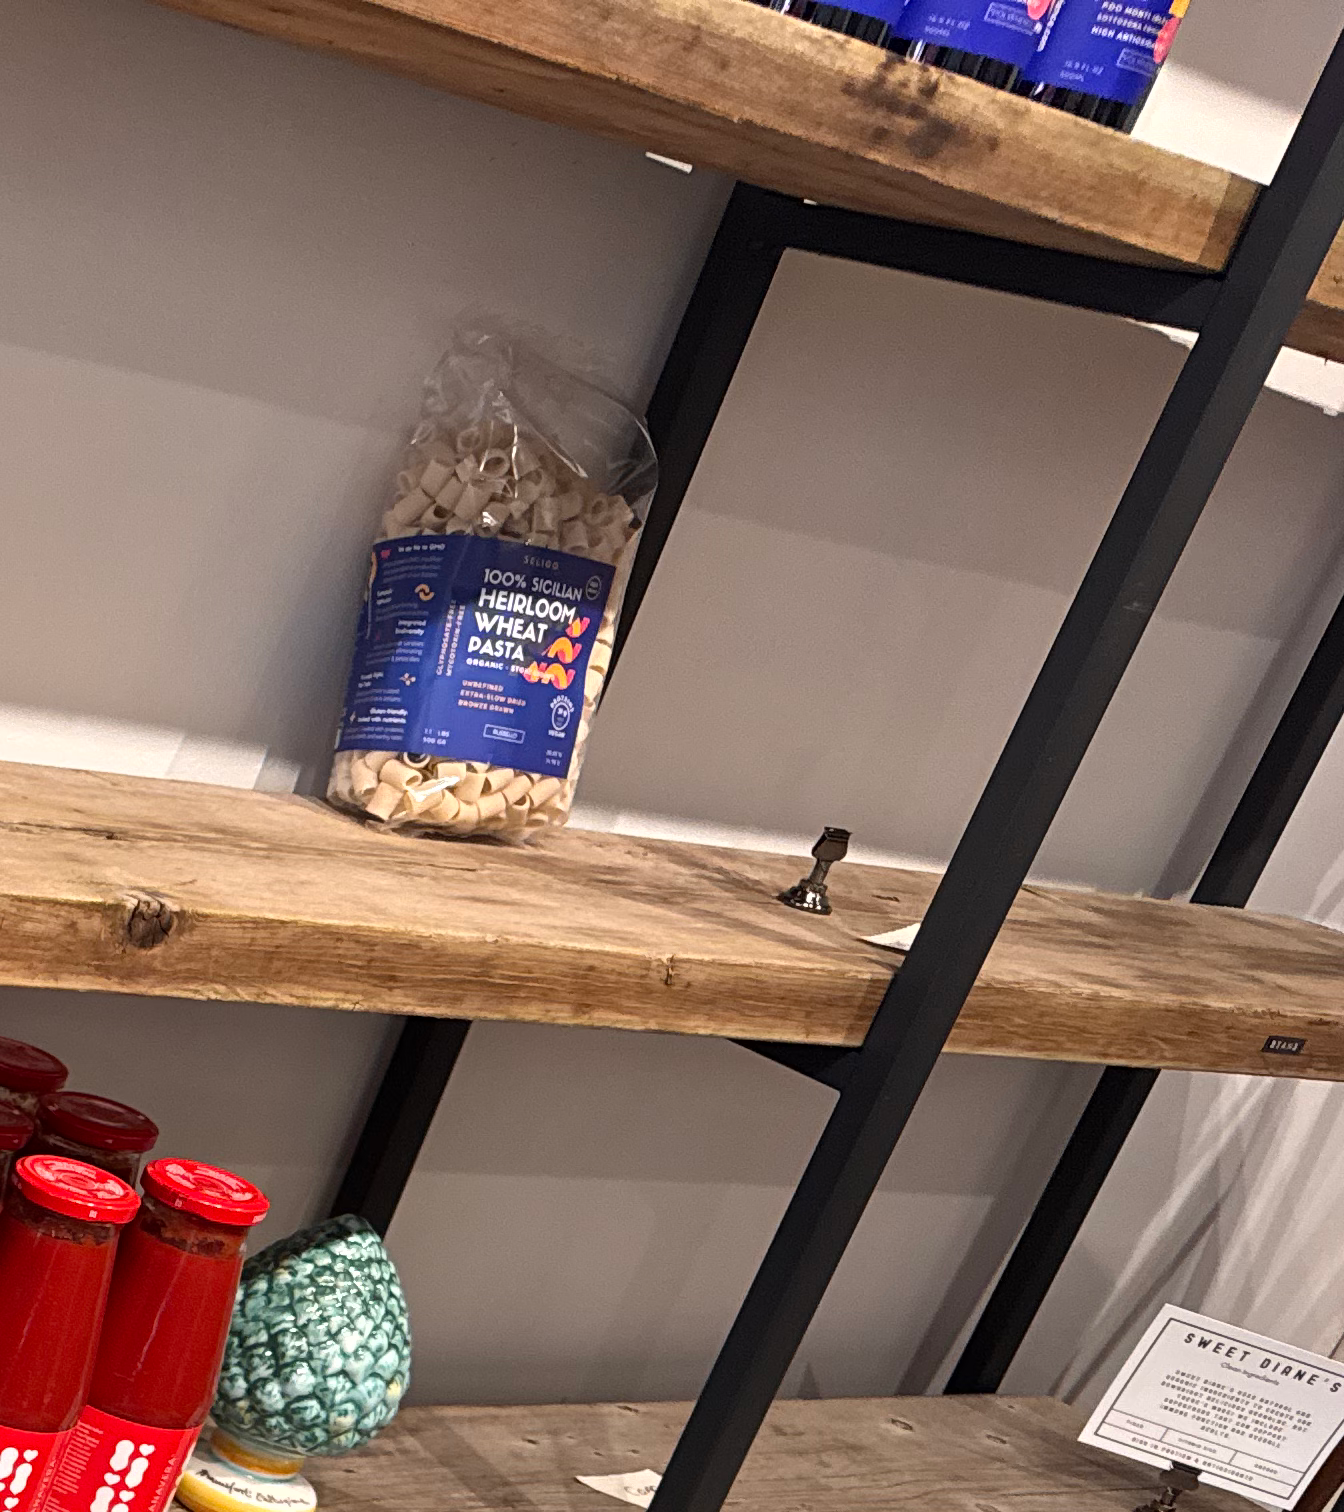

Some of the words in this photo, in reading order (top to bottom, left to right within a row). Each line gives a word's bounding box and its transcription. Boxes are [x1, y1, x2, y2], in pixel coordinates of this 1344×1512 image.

[484, 569, 526, 588] 100%
[532, 577, 582, 601] SICILIAN
[478, 588, 577, 624] HEIRLOOM
[475, 612, 548, 643] WHEAT
[466, 658, 503, 670] ORGANIC
[468, 636, 524, 662] PASTA
[1184, 1332, 1251, 1362] SWEET
[1260, 1358, 1342, 1393] DIANE'S
